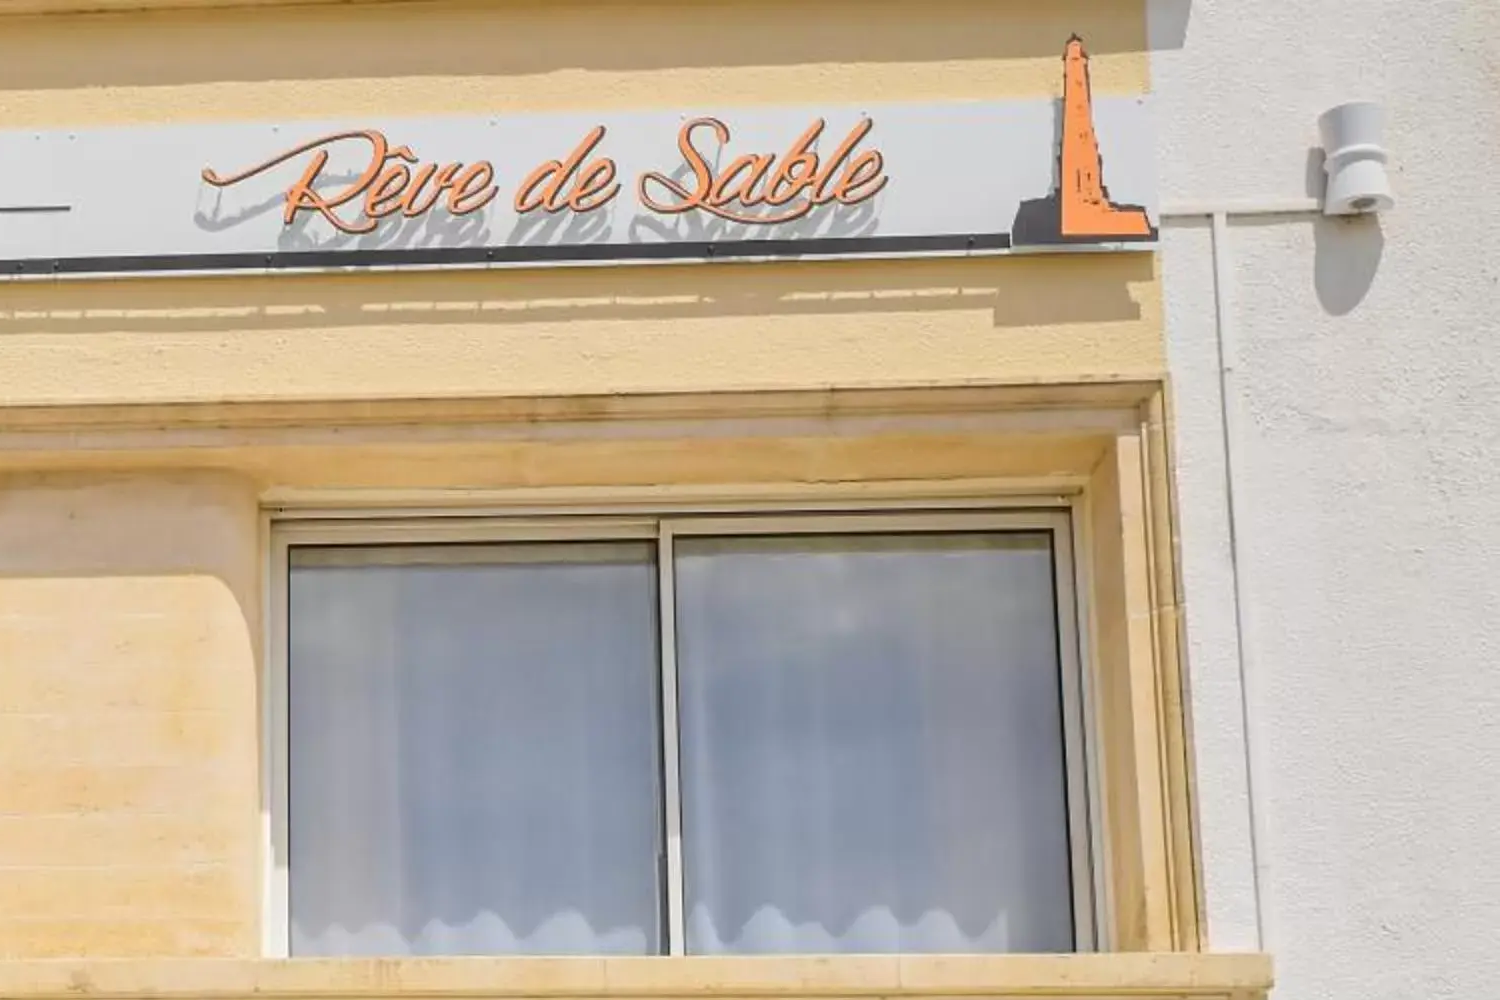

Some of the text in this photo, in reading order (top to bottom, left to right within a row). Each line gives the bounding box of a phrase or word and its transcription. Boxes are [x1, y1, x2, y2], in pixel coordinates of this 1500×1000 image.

[200, 129, 499, 234] Rêve
[513, 125, 621, 214] de
[637, 116, 889, 225] Sable
